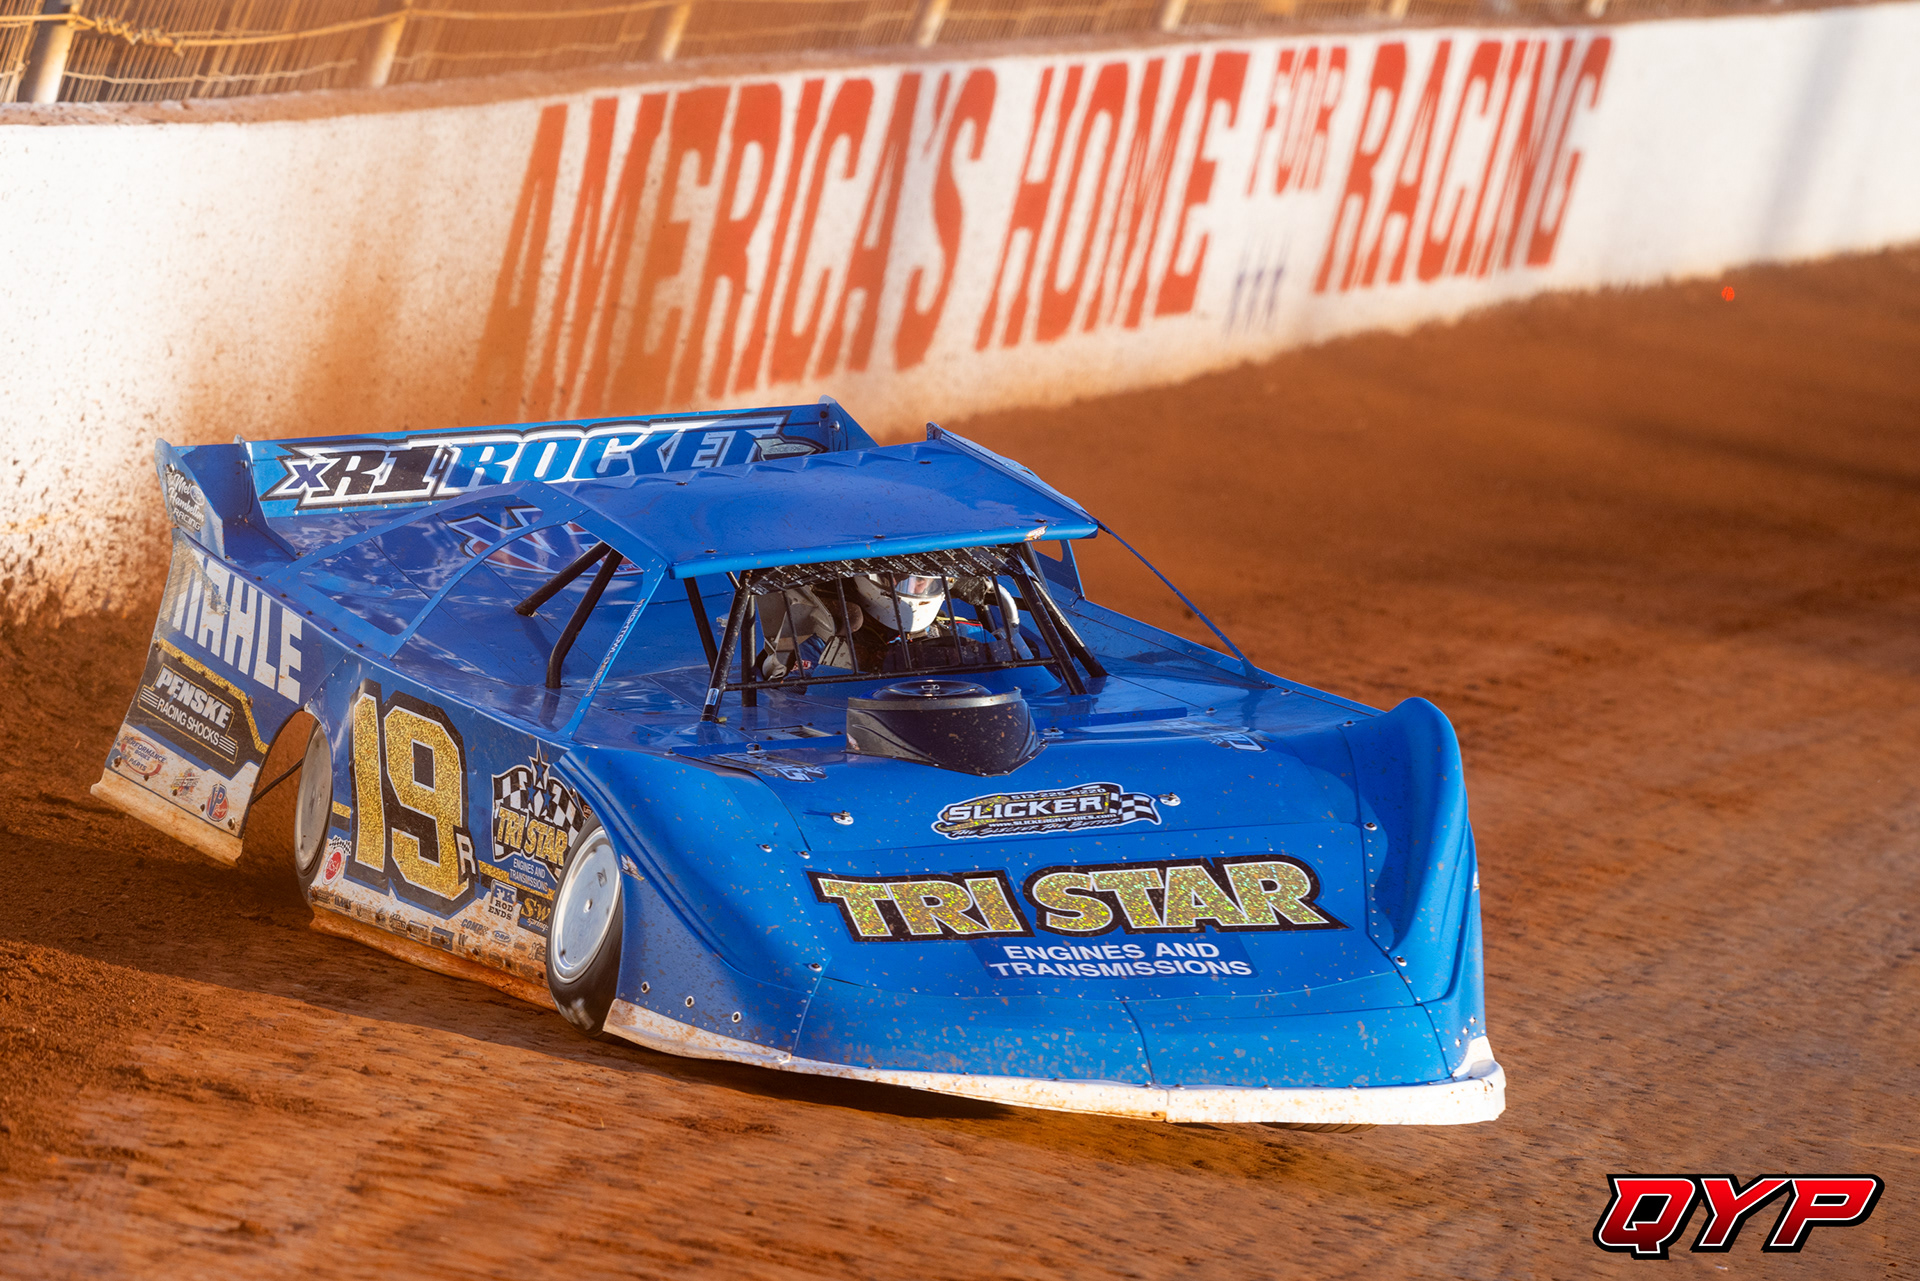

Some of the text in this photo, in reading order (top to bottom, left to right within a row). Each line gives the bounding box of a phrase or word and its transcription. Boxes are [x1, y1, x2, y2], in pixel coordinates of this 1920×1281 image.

[974, 50, 1250, 352] HOME
[1244, 46, 1348, 198] FOR
[1313, 36, 1613, 295] RACING
[173, 507, 201, 531] RACING
[155, 667, 232, 729] PENSKE
[156, 698, 220, 746] RACING SHOCKS
[123, 735, 166, 763] PERFORMANCE
[128, 757, 148, 772] PARTS
[948, 796, 1104, 821] SLICKER
[497, 806, 568, 867] TRI STAR
[509, 868, 549, 893] TRANSMISSIONS
[513, 858, 546, 879] ENGINES AND
[494, 899, 514, 913] ROD
[816, 860, 1331, 938] TRI STAR
[488, 905, 513, 921] ENDS
[1002, 942, 1221, 961] ENGINES AND
[989, 959, 1253, 977] TRANSMISSIONS
